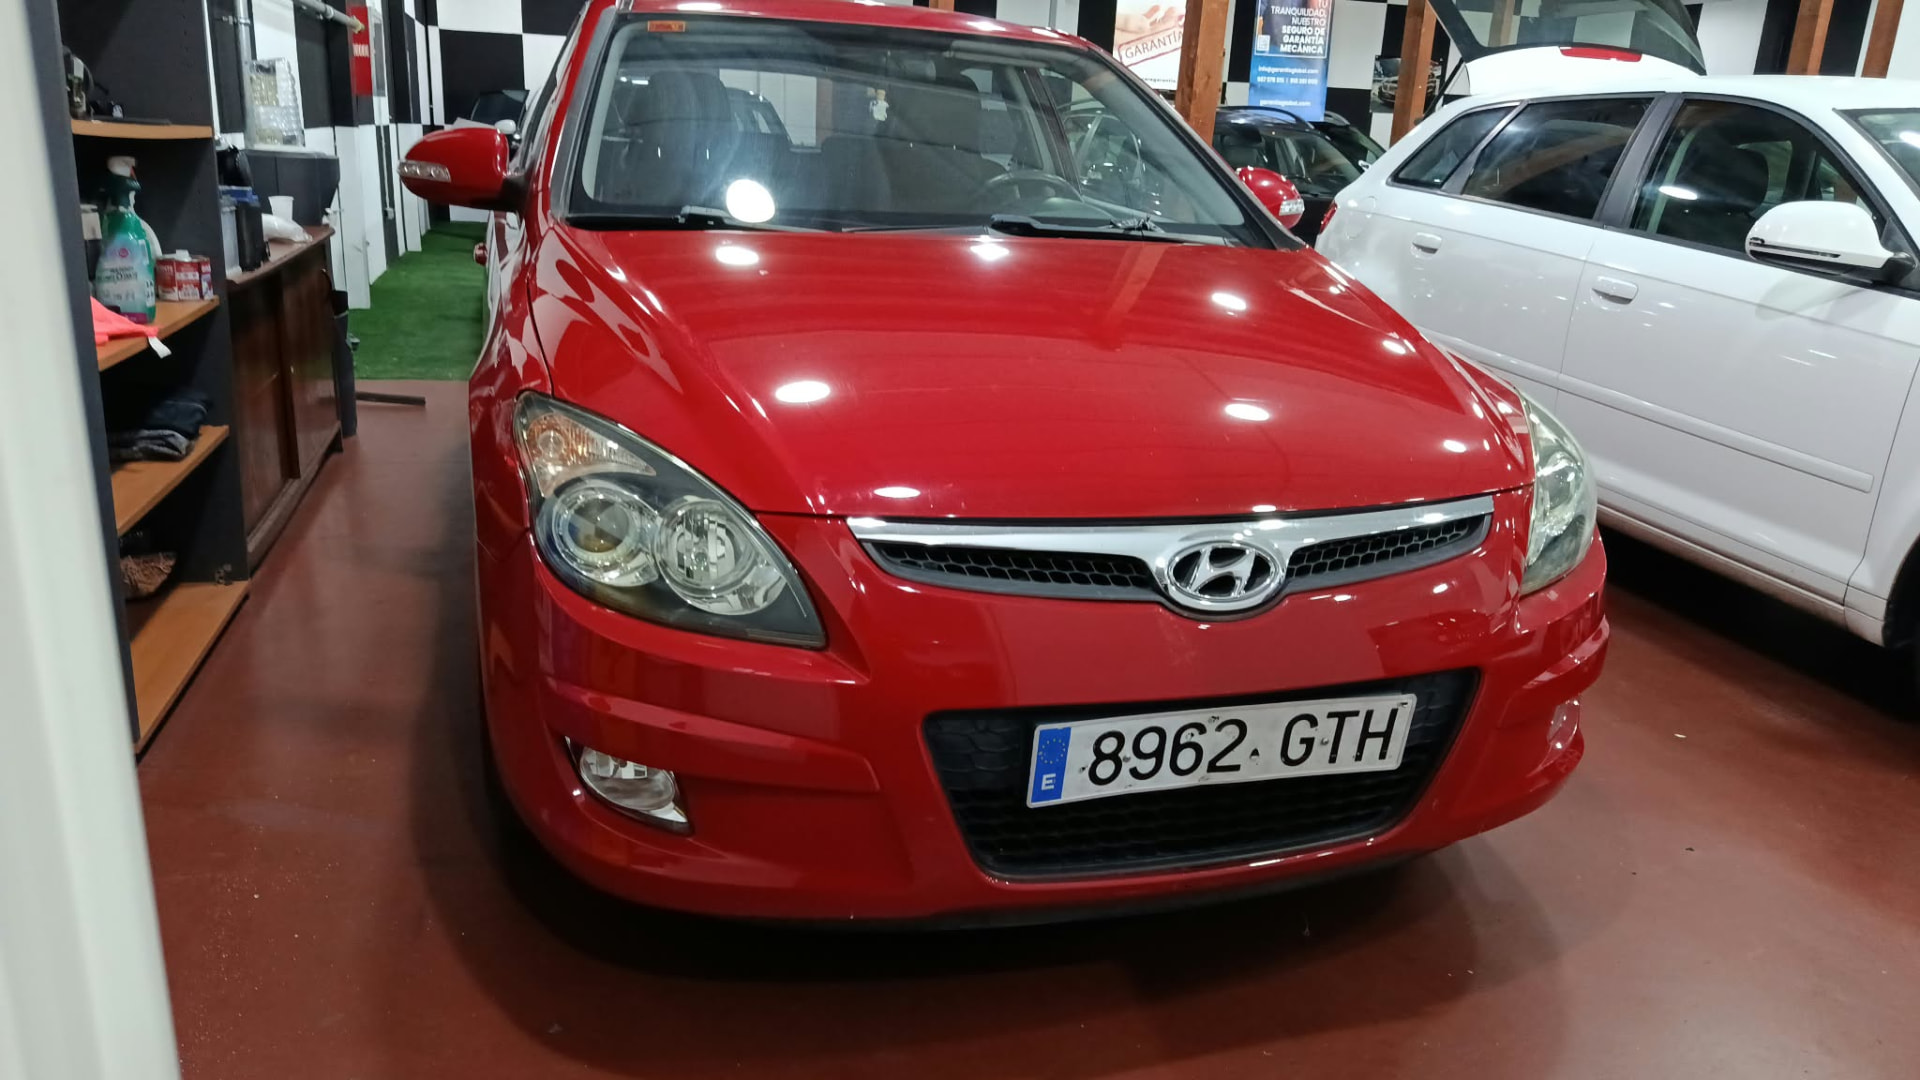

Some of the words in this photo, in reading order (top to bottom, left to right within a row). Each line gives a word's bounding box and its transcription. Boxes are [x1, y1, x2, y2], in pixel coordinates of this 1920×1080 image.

[1292, 17, 1326, 26] NUESTRO
[1282, 25, 1313, 35] SEGURO
[1314, 27, 1325, 36] DE
[1283, 34, 1324, 45] GARANTÍA
[1280, 43, 1323, 54] MECÁNICA
[1088, 719, 1248, 786] 8962
[1280, 708, 1399, 767] GTH
[1041, 773, 1057, 791] E
